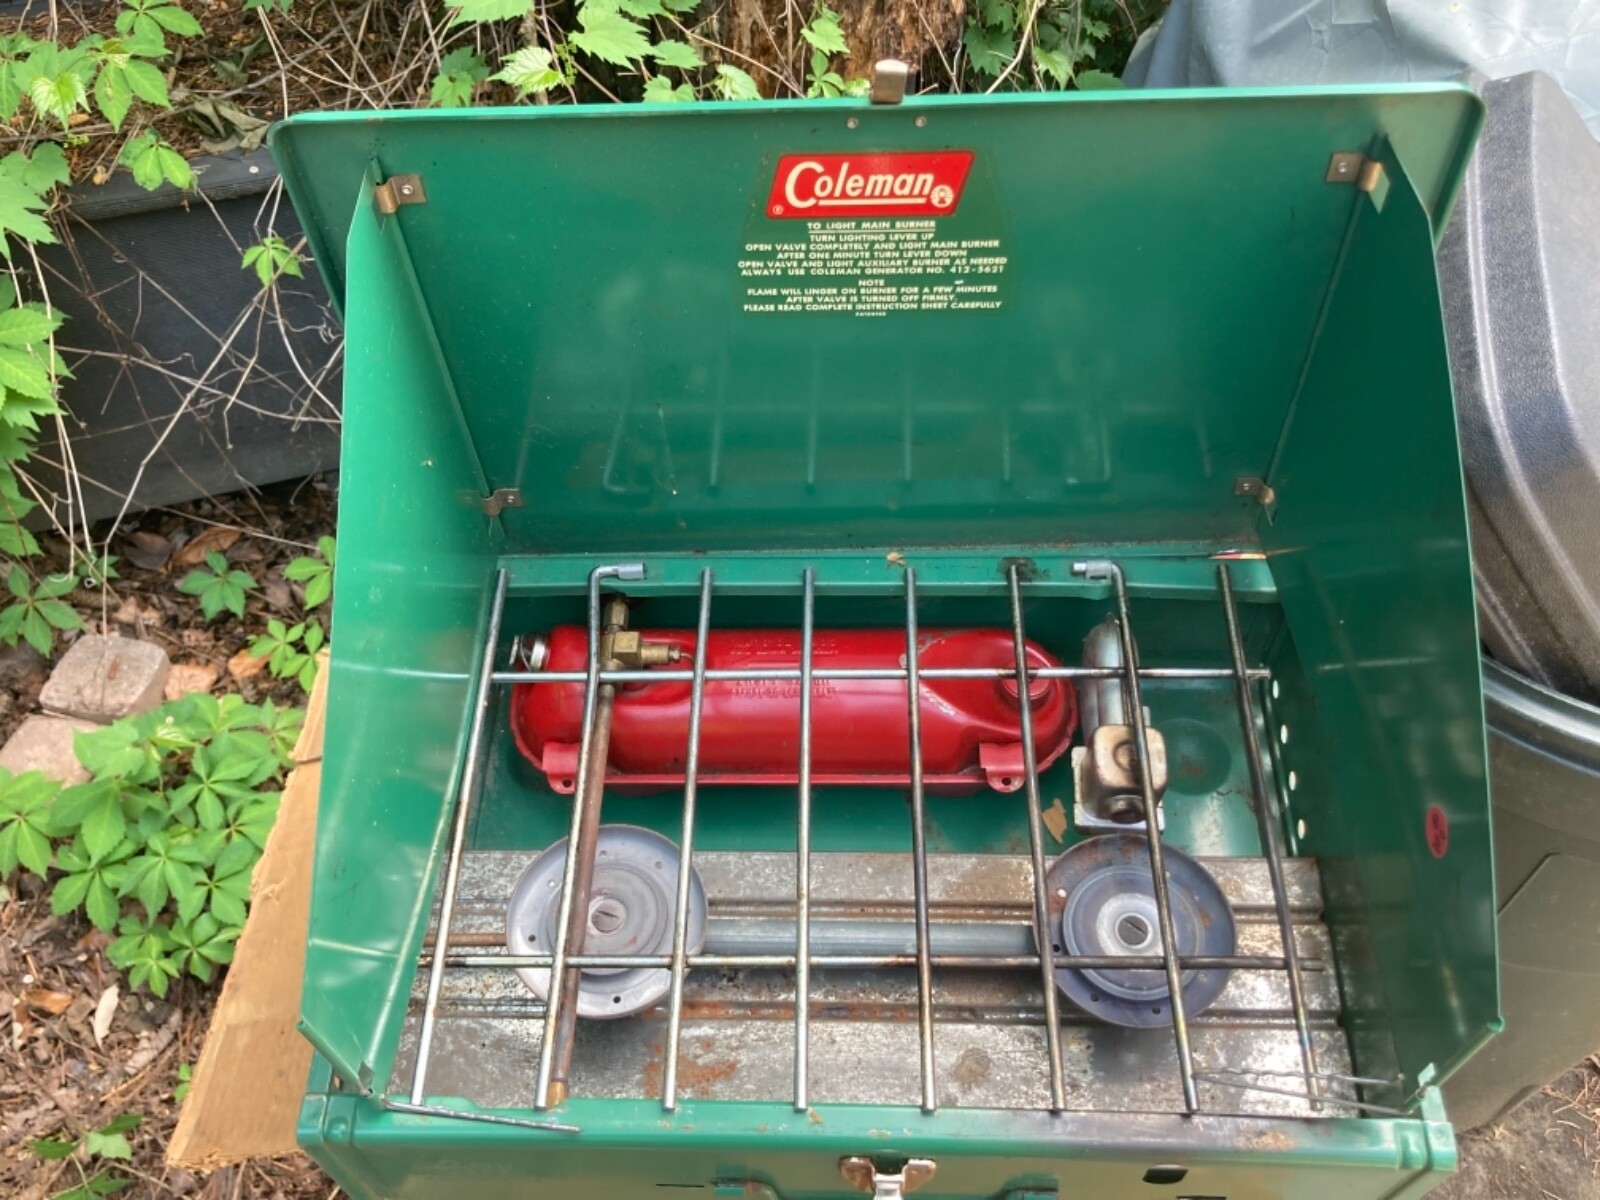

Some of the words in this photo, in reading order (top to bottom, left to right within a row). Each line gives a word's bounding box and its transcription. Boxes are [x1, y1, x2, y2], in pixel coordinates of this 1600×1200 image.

[785, 161, 934, 208] Coleman
[862, 221, 890, 229] MAIN
[895, 220, 936, 228] BURNER
[840, 234, 886, 242] LIGHTING
[775, 243, 806, 251] VALVE
[873, 242, 896, 250] AND
[961, 240, 1000, 248] BURNER
[833, 251, 870, 259] MINUTE
[903, 250, 931, 258] LEVER
[954, 258, 967, 266] AS
[970, 257, 1007, 265] NEEDED
[741, 268, 781, 276] ALWAYS
[864, 266, 923, 275] GENERATOR
[747, 288, 778, 296] FLAME
[841, 287, 856, 295] ON
[955, 285, 998, 293] MINUTES
[744, 304, 775, 312] PLEASE
[950, 301, 1002, 309] CAREFULLY
